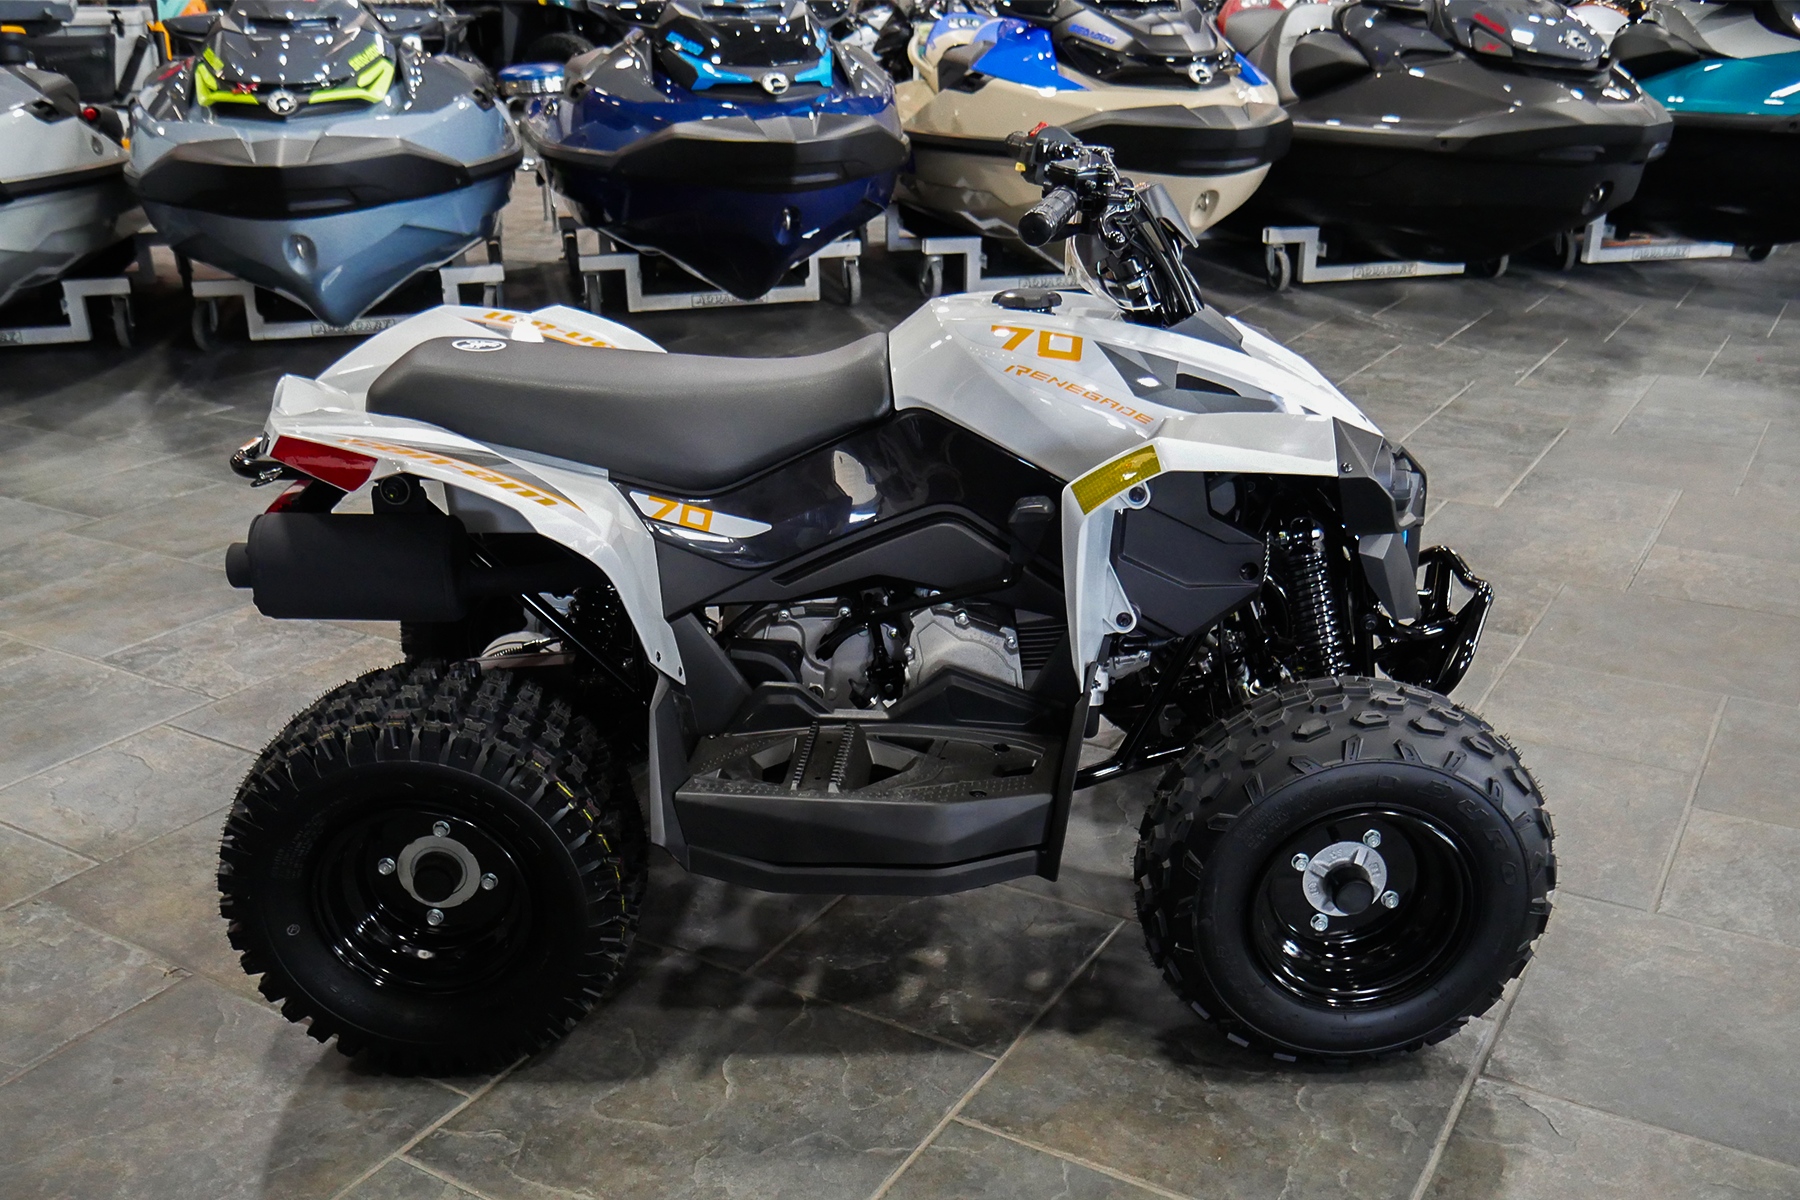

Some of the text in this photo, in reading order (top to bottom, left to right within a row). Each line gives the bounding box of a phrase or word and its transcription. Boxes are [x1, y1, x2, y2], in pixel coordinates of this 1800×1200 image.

[990, 325, 1084, 362] 70
[1004, 364, 1154, 425] RENEGADE
[648, 495, 714, 533] 70
